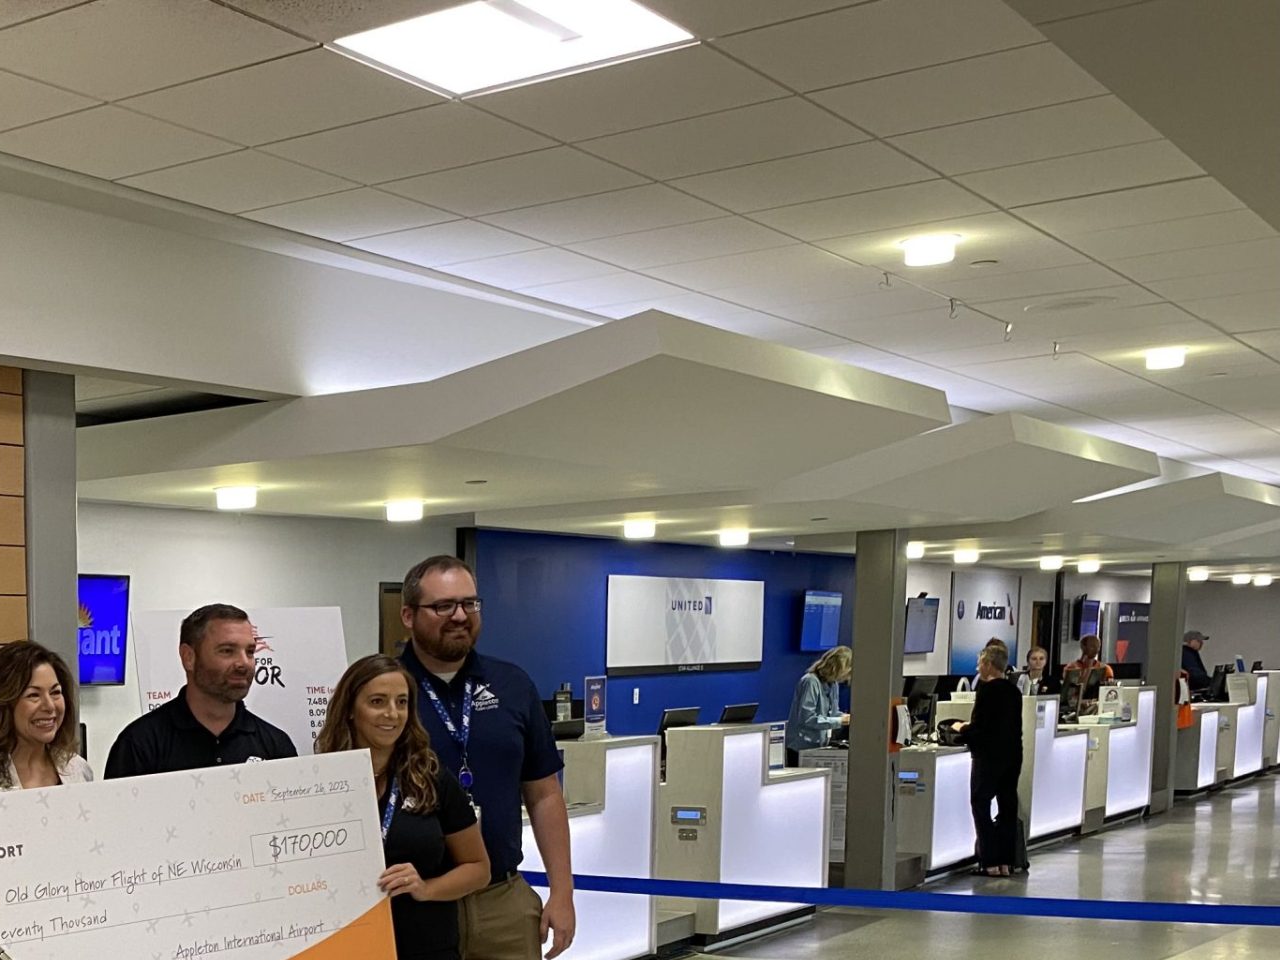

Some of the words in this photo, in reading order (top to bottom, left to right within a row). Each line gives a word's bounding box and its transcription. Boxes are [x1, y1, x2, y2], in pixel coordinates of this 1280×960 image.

[671, 599, 704, 612] UNITED
[976, 601, 1005, 620] American
[147, 692, 171, 700] TEAM
[306, 686, 326, 694] TIME
[242, 792, 265, 804] DATE
[272, 784, 312, 800] September
[328, 780, 350, 792] 2023
[269, 828, 348, 862] $170,000
[6, 886, 28, 903] Old
[34, 882, 71, 902] Glory
[75, 878, 107, 893] Honor
[111, 870, 148, 894] Flight
[151, 866, 164, 886] of
[167, 862, 188, 878] NE
[191, 854, 242, 875] Wisconsin
[288, 880, 328, 896] DOLLARS
[50, 909, 107, 931] Thousand
[224, 927, 284, 950] International
[289, 920, 324, 942] Airport
